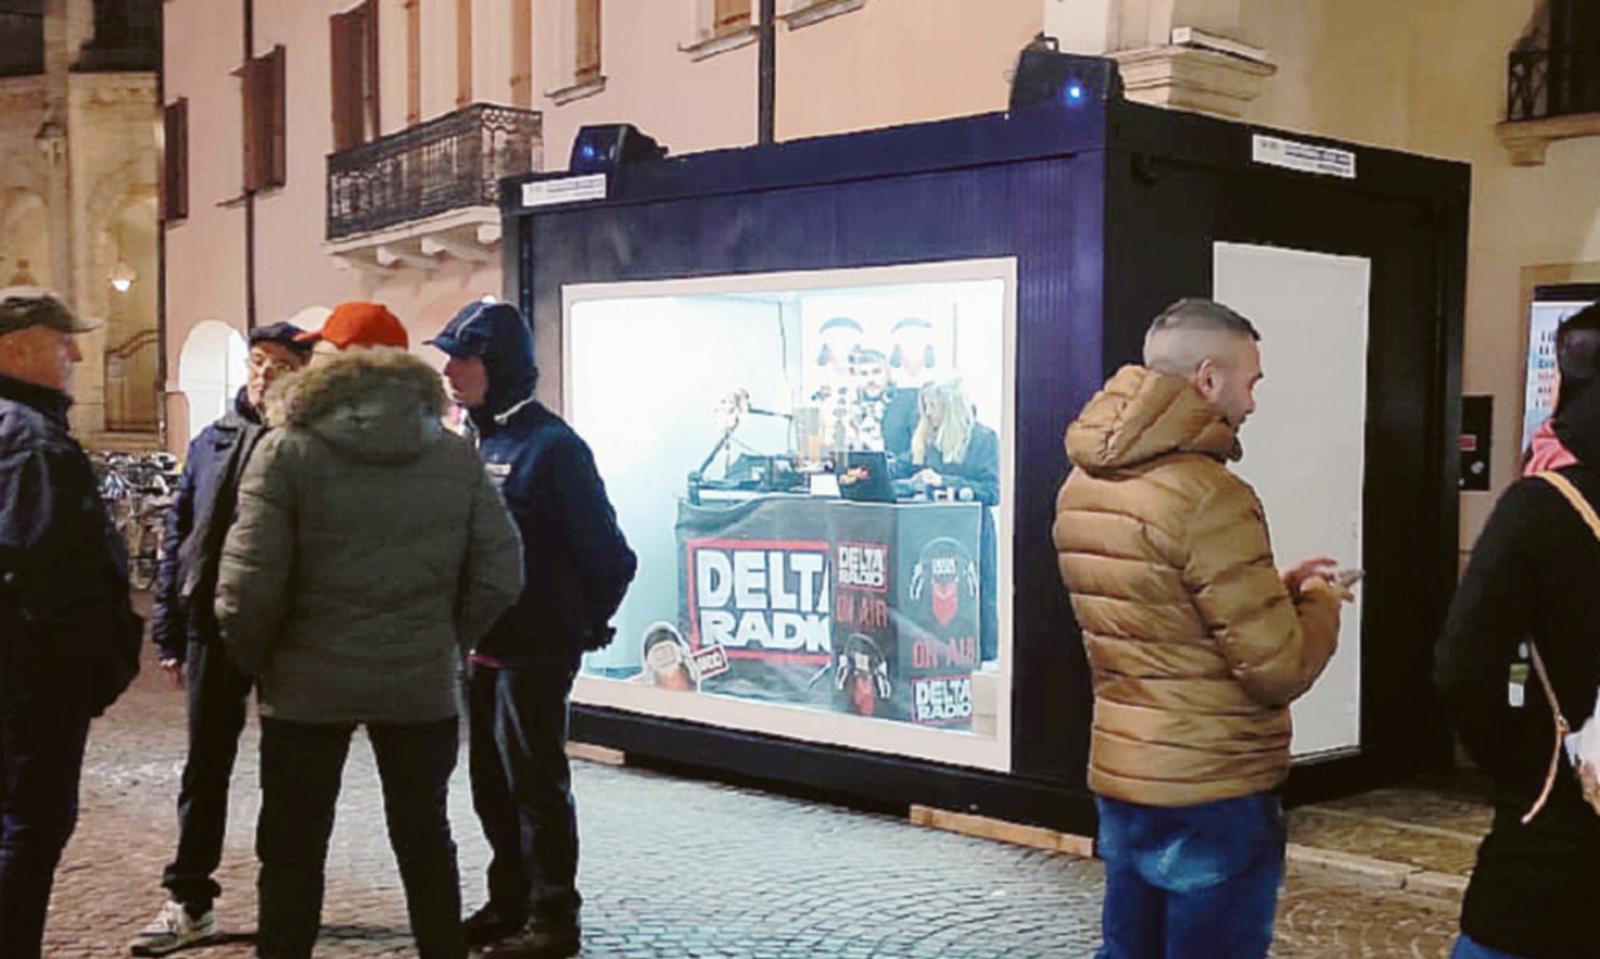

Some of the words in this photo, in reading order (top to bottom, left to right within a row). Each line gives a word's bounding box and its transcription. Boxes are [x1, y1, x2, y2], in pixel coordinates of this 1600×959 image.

[838, 546, 884, 572] DELTA
[916, 680, 970, 704] DELTA
[918, 702, 971, 720] RADIO
